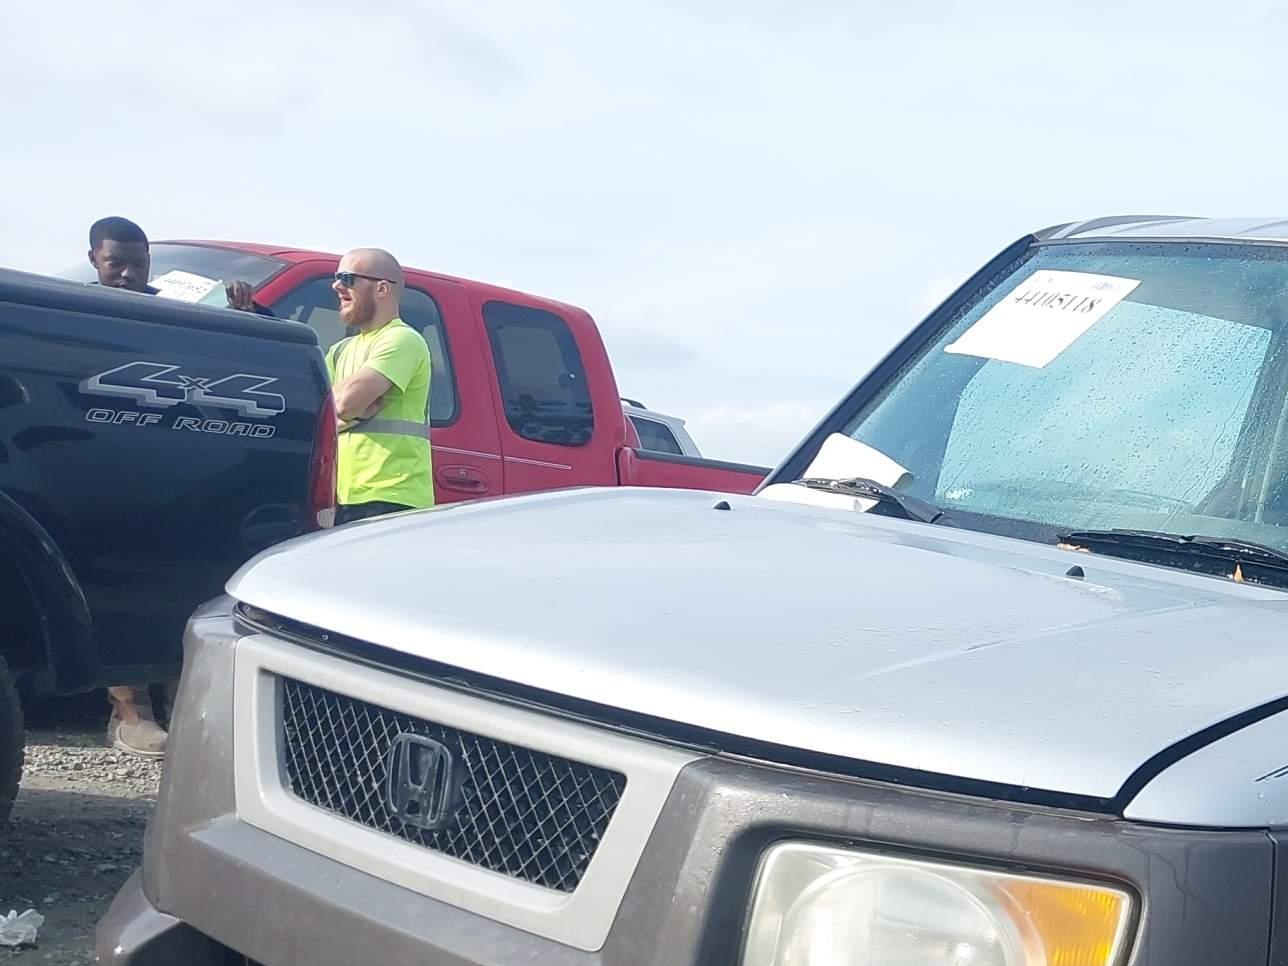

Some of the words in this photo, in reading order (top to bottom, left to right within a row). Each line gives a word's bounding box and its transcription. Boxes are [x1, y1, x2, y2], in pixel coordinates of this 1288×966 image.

[1015, 290, 1102, 312] 44105118
[86, 408, 163, 426] OFF
[172, 416, 276, 438] ROAD
